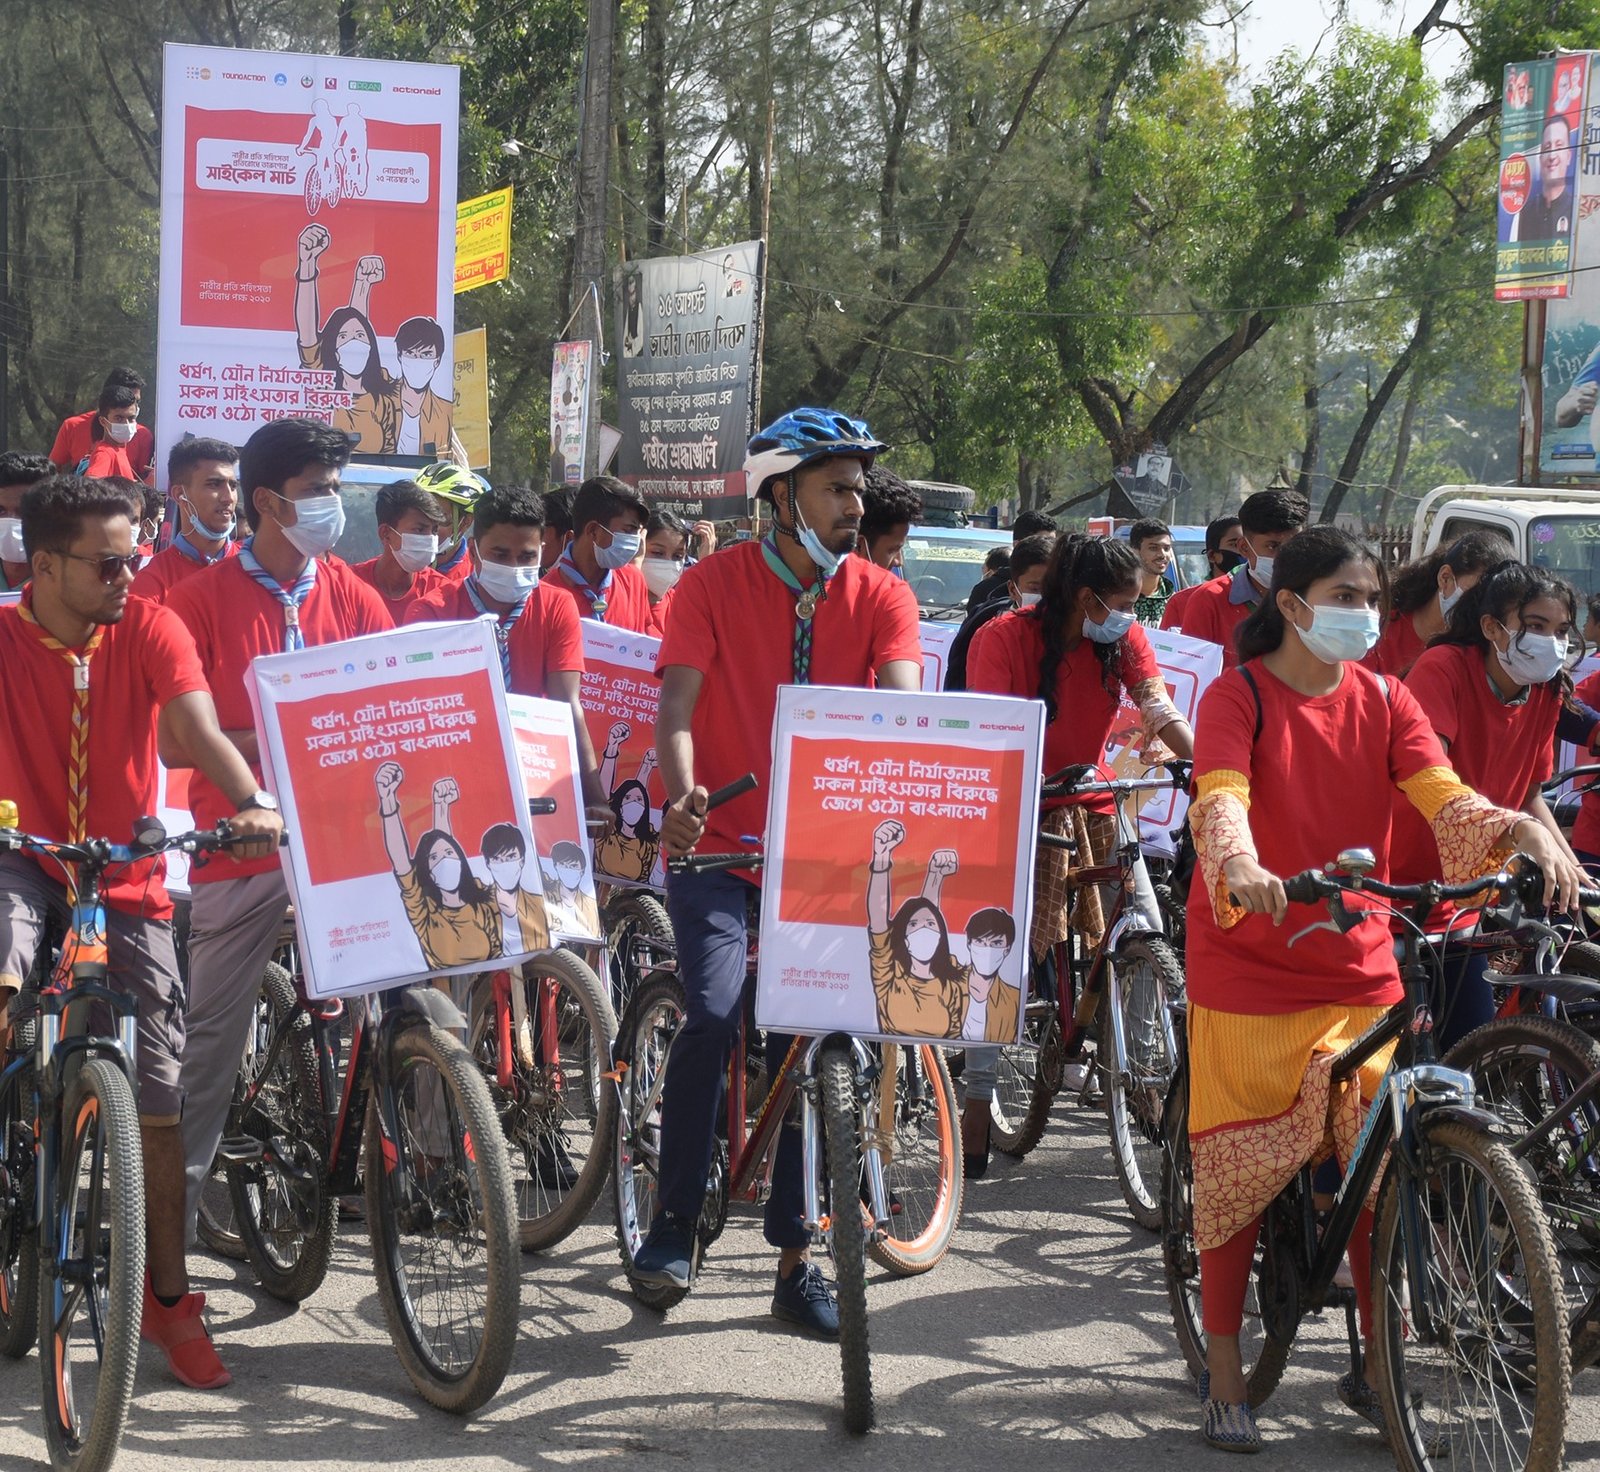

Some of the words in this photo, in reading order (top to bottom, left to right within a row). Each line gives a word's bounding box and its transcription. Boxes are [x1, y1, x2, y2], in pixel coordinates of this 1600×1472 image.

[393, 86, 441, 96] actionaid
[206, 164, 266, 184] সাইকেল
[270, 166, 296, 184] মার্চ
[199, 289, 230, 301] প্রতিরোধ
[250, 295, 271, 303] ২০২০
[200, 279, 221, 290] নারীর
[223, 281, 238, 291] প্রতি
[240, 282, 272, 293] সহিংসতা
[658, 293, 673, 318] ১৫
[675, 282, 707, 316] আগস্ট
[650, 323, 681, 358] জাতীয়
[685, 329, 711, 355] শোক
[714, 315, 746, 353] দিবস
[179, 362, 217, 382] ধর্ষণ,
[221, 364, 254, 382] যৌন
[259, 365, 334, 387] নির্যাতনসহ
[695, 364, 718, 384] জাতির
[179, 384, 218, 400] সকল
[223, 383, 299, 404] সহিংসতার
[304, 387, 352, 408] বিরুদ্ধে
[692, 392, 717, 408] রহমান
[178, 403, 217, 420] জেগে
[221, 403, 256, 422] ওঠো
[642, 436, 668, 469] গভীর
[611, 679, 636, 693] যৌন
[311, 710, 349, 731] ধর্ষণ,
[354, 704, 386, 724] যৌন
[390, 693, 465, 718] নির্যাতনসহ
[306, 734, 346, 751] সকল
[350, 719, 425, 745] সহিংসতার
[428, 710, 477, 730] বিরুদ্ধে
[979, 723, 1025, 732] actionaid
[319, 748, 358, 768] জেগে
[362, 740, 396, 760] ওঠো
[399, 729, 471, 752] বাংলাদেশ
[823, 756, 864, 776] ধর্ষণ,
[868, 758, 904, 777] যৌন
[909, 760, 991, 783] নির্যাতনসহ
[813, 776, 854, 793] সকল
[860, 777, 941, 799] সহিংসতার
[946, 782, 998, 803] বিরুদ্ধে
[822, 796, 863, 812] জেগে
[868, 797, 904, 815] ওঠো
[909, 801, 987, 821] বাংলাদেশ
[781, 967, 801, 978] নারীর
[803, 968, 817, 979] প্রতি
[819, 970, 850, 981] সহিংসতা
[781, 977, 810, 988] প্রতিরোধ
[829, 982, 849, 991] ২০২০
